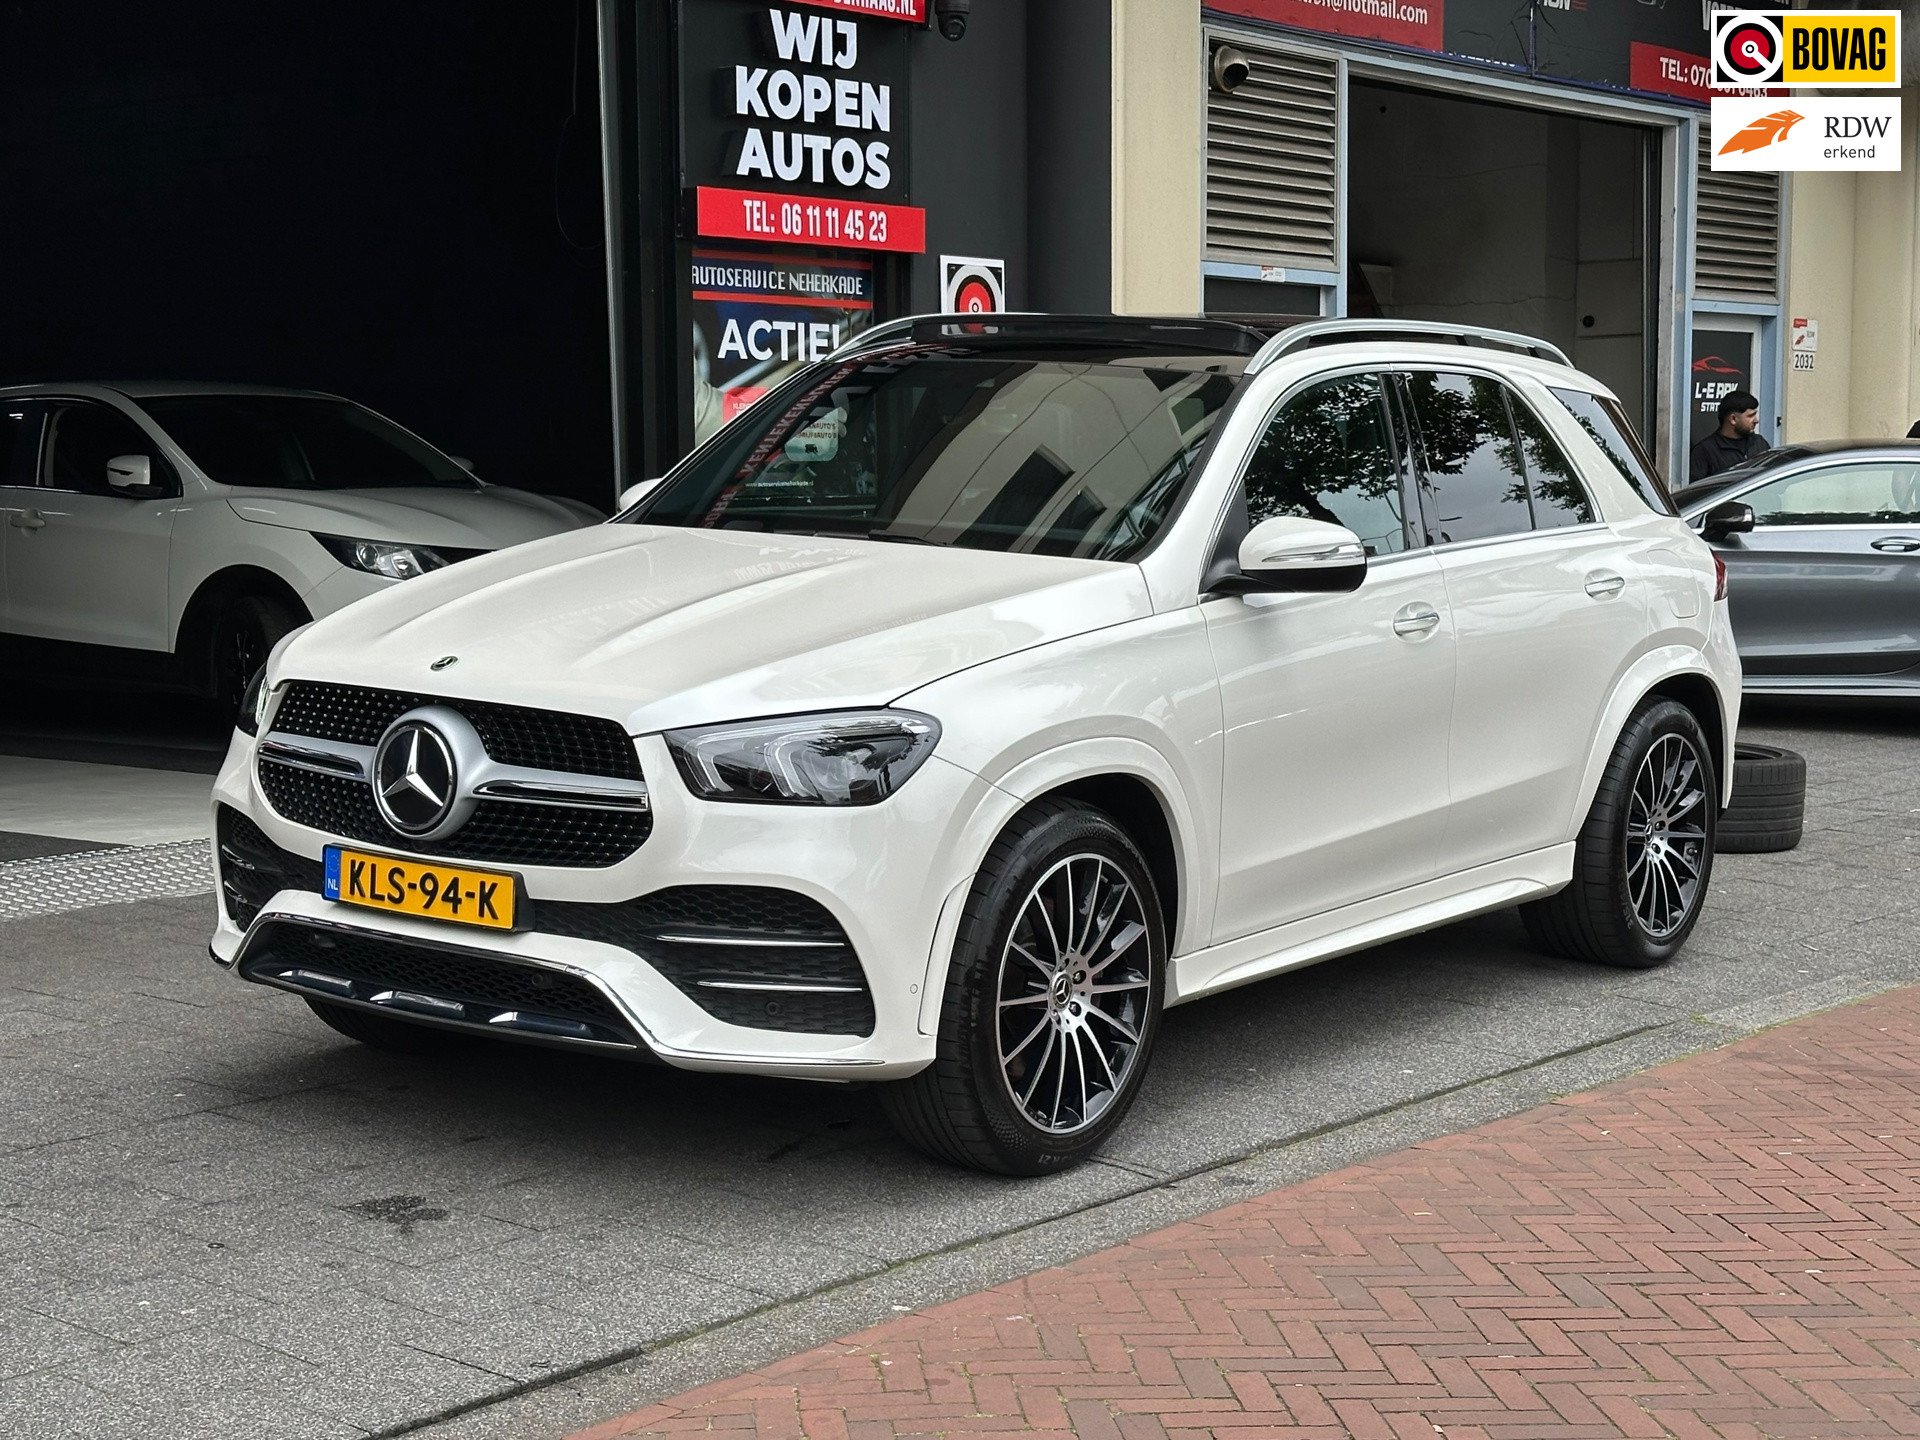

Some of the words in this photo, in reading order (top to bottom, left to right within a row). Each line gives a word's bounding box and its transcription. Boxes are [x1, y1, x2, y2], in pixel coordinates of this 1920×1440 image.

[769, 8, 857, 69] WIJ
[1660, 56, 1688, 83] TEL:
[735, 65, 890, 132] KOPEN
[736, 128, 891, 190] AUTOS
[743, 199, 775, 234] TEL:
[781, 202, 801, 236] 06
[806, 205, 821, 237] 11
[825, 207, 840, 239] 11
[844, 209, 865, 241] 45
[868, 211, 888, 243] 23
[691, 265, 786, 290] AUTOSERVICE
[789, 272, 863, 295] NEHERKADE
[1794, 353, 1814, 369] 2032
[1700, 401, 1721, 412] STAT
[327, 877, 339, 891] NL
[349, 858, 499, 920] KLS-94-K
